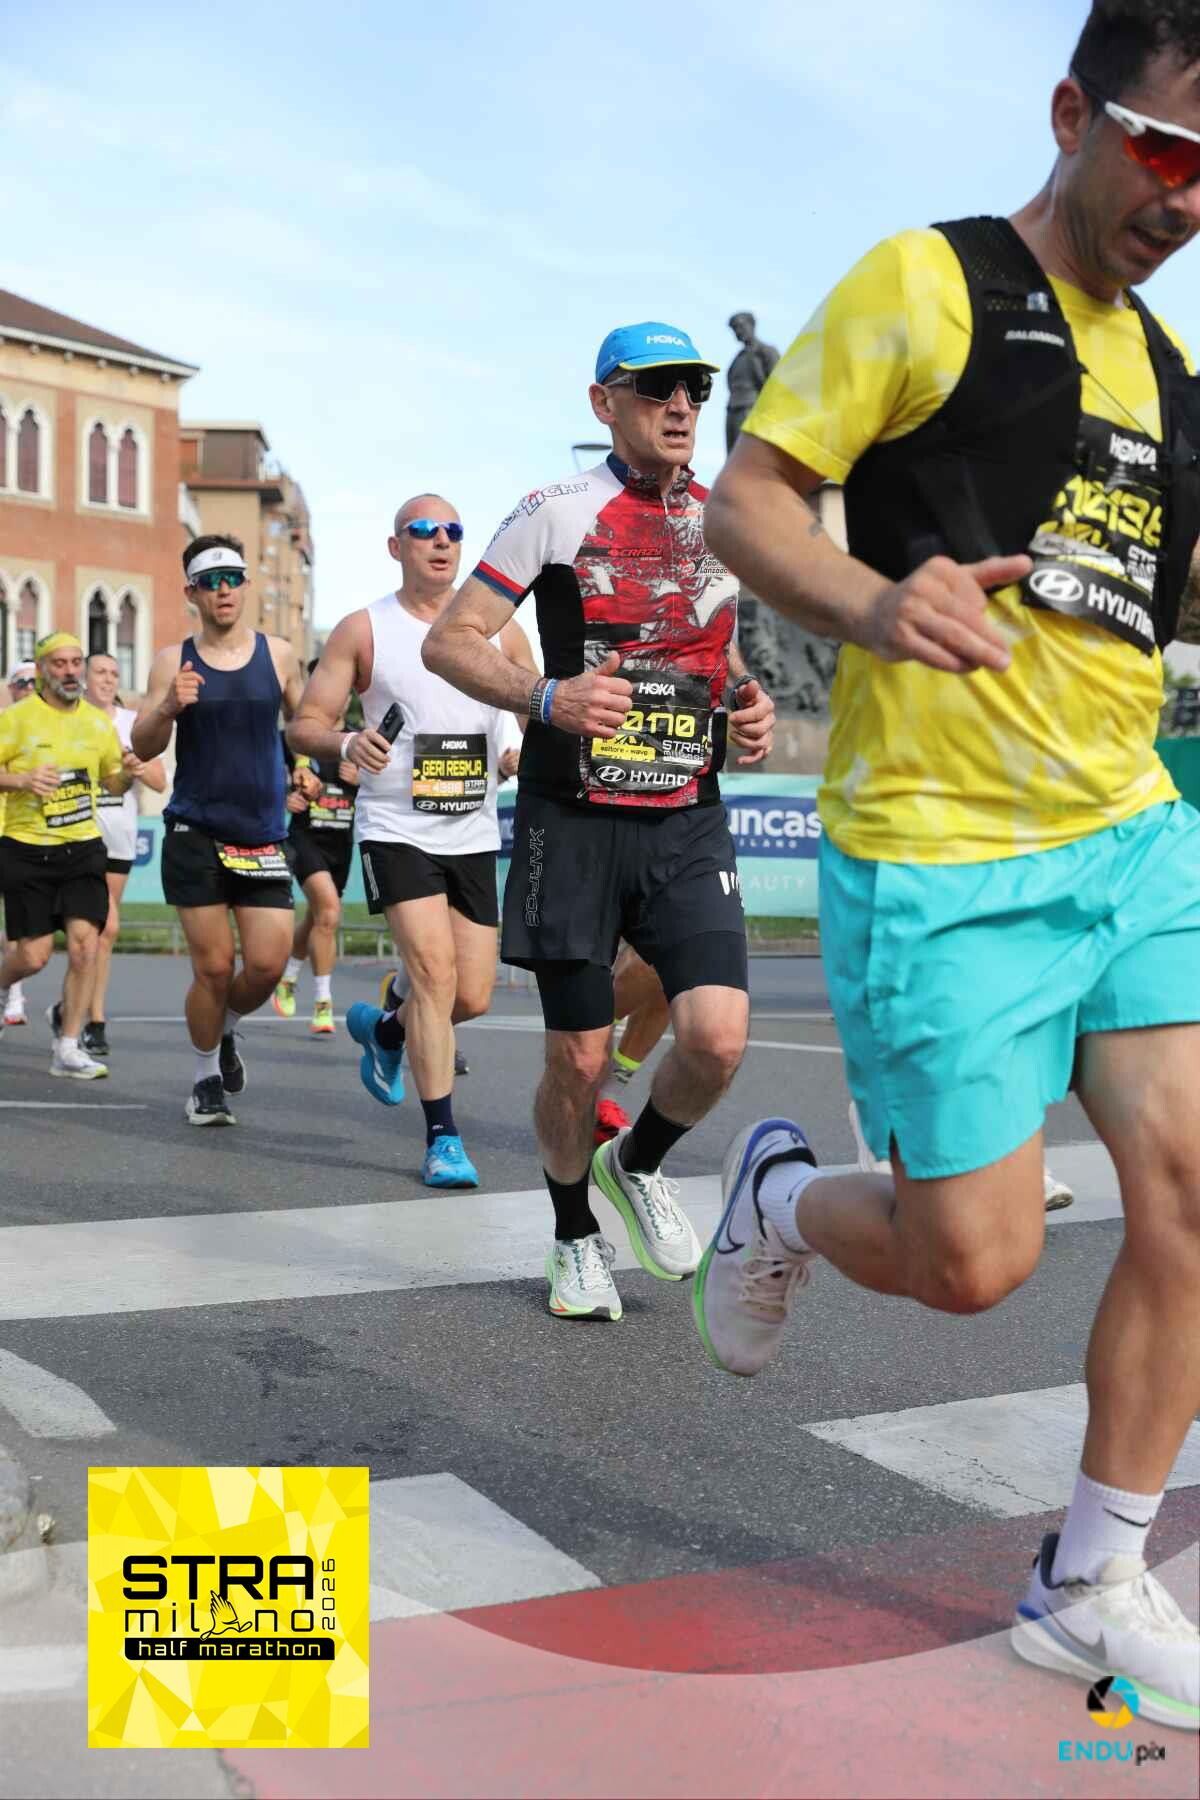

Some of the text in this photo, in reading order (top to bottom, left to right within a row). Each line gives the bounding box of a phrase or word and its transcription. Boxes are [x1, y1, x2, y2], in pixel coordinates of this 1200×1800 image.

[646, 335, 685, 346] HOKA
[1108, 432, 1158, 465] HOKA
[637, 682, 676, 697] HOKA
[617, 710, 696, 738] 0170
[440, 739, 468, 750] HOKA
[662, 739, 700, 754] STRA
[629, 769, 693, 787] HYUND
